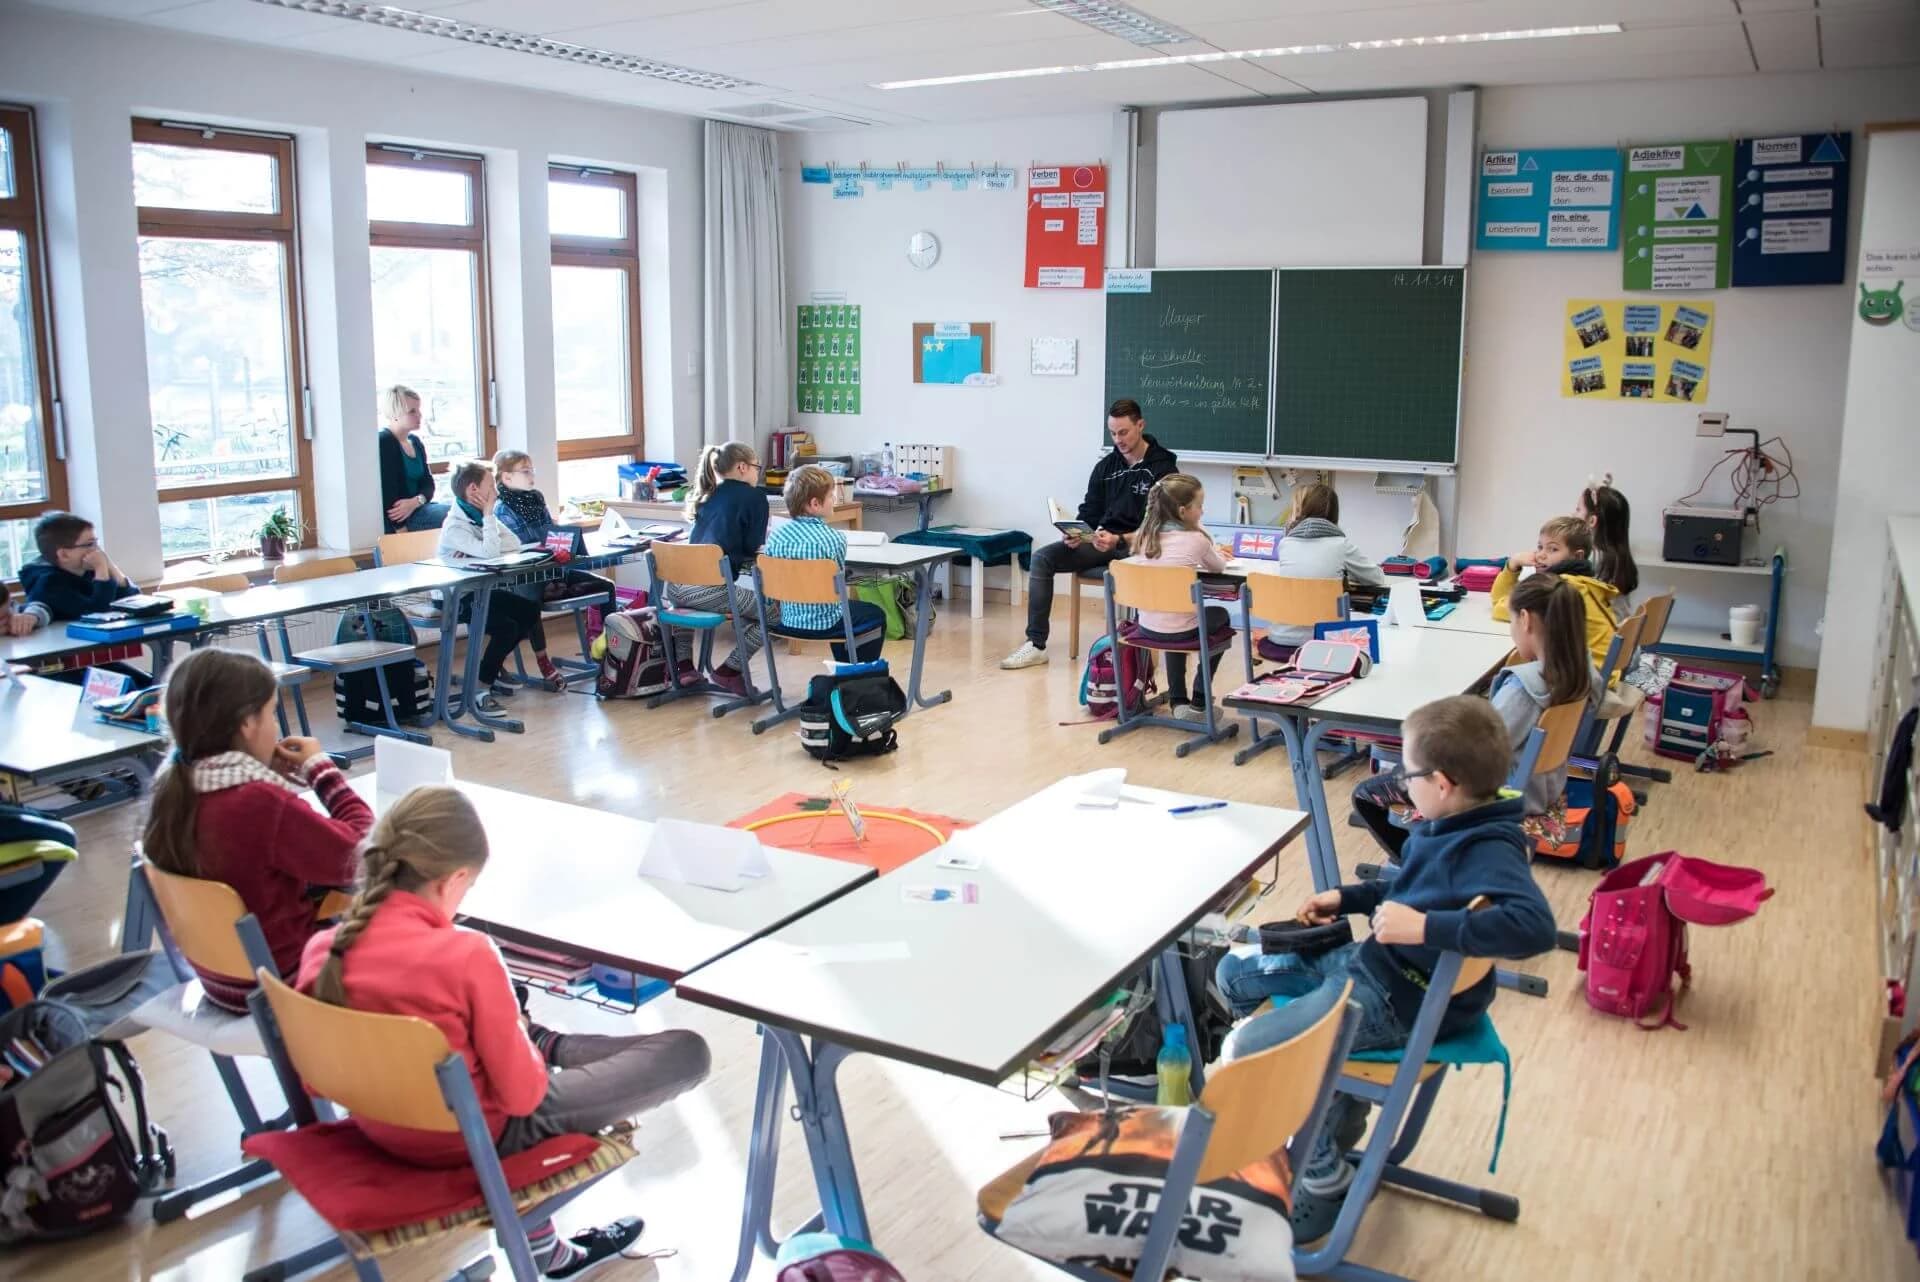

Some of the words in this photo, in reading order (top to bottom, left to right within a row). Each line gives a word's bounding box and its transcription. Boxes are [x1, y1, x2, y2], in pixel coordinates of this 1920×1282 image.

[1757, 142, 1798, 153] Nomen
[1632, 149, 1681, 160] Adjektive
[1485, 155, 1516, 165] Artikel
[1032, 170, 1058, 180] Verben
[1491, 186, 1529, 194] bestimmt
[1488, 225, 1537, 234] unbestimmt
[1085, 1183, 1243, 1227] STR
